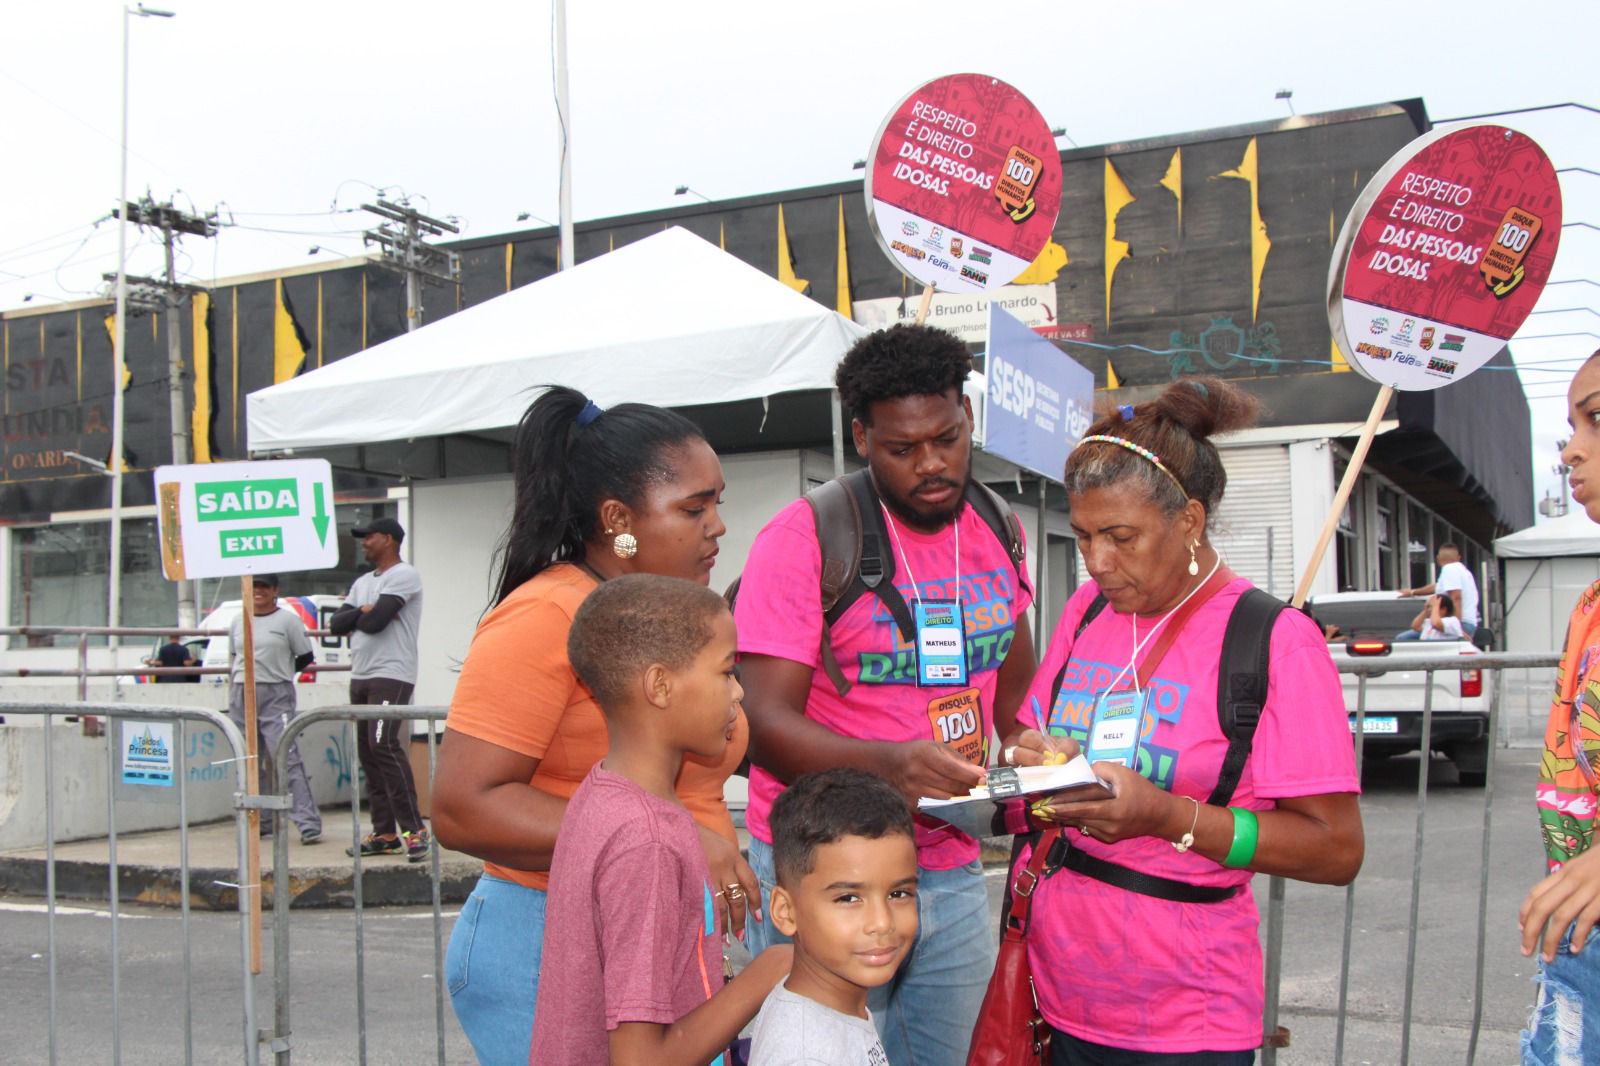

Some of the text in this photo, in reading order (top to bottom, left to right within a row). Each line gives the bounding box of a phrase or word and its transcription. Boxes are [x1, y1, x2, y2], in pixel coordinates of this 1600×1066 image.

[912, 101, 977, 137] RESPEITO
[905, 119, 974, 159] É DIREITO
[899, 142, 995, 190] DAS PESSOAS
[1006, 158, 1034, 186] 100
[1015, 150, 1036, 166] DISQUE
[893, 162, 950, 197] IDOSAS.
[1400, 172, 1472, 206] RESPEITO
[1389, 194, 1464, 233] É DIREITO
[1512, 211, 1535, 228] DISQUE
[1379, 225, 1482, 265] DAS PESSOAS
[1497, 222, 1530, 252] 100
[927, 254, 949, 270] Feira
[1368, 251, 1432, 281] IDOSAS.
[935, 301, 973, 317] Bruno
[1393, 351, 1415, 366] Feira
[991, 356, 1035, 420] SESP
[199, 486, 297, 514] SAÍDA
[226, 535, 277, 552] EXIT
[938, 695, 973, 712] DISQUE
[937, 708, 977, 744] 100
[128, 744, 169, 757] Princesa
[138, 736, 160, 746] Toldos
